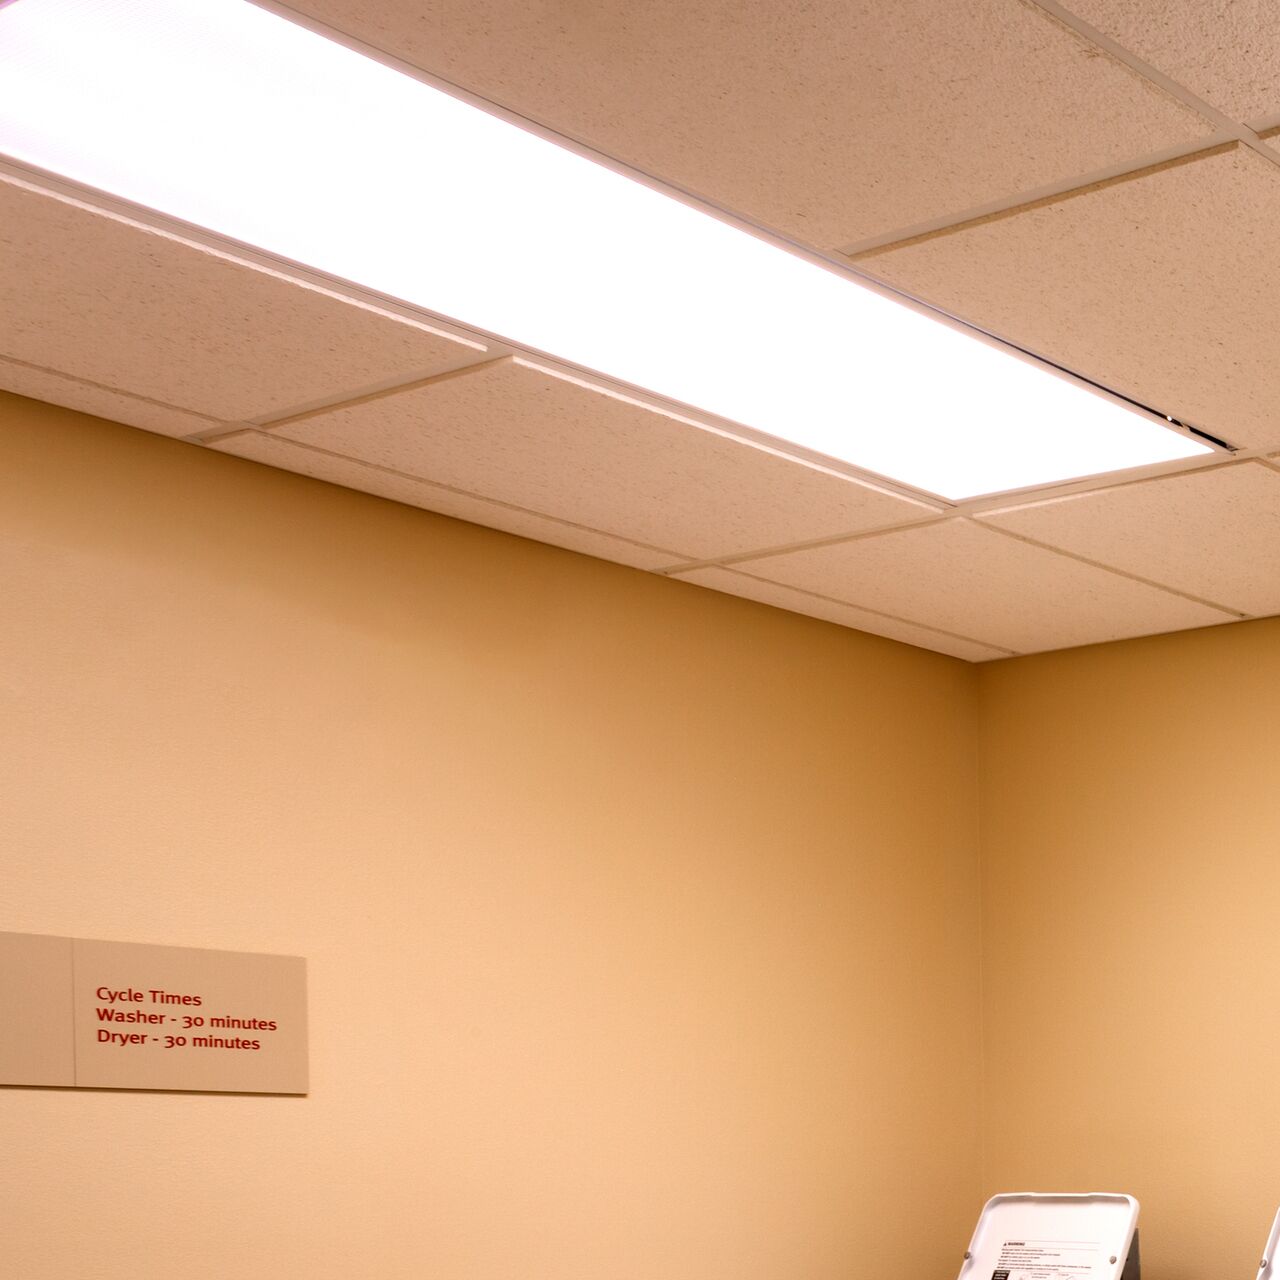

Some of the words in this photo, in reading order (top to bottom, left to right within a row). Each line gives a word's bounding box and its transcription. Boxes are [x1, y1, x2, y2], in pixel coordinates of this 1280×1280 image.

[96, 987, 143, 1003] Cycle
[149, 990, 202, 1006] Times
[96, 1008, 166, 1024] Washer
[182, 1016, 204, 1028] 30
[210, 1016, 277, 1031] minutes
[98, 1029, 148, 1046] Dryer
[164, 1036, 186, 1048] 30
[192, 1035, 260, 1049] minutes
